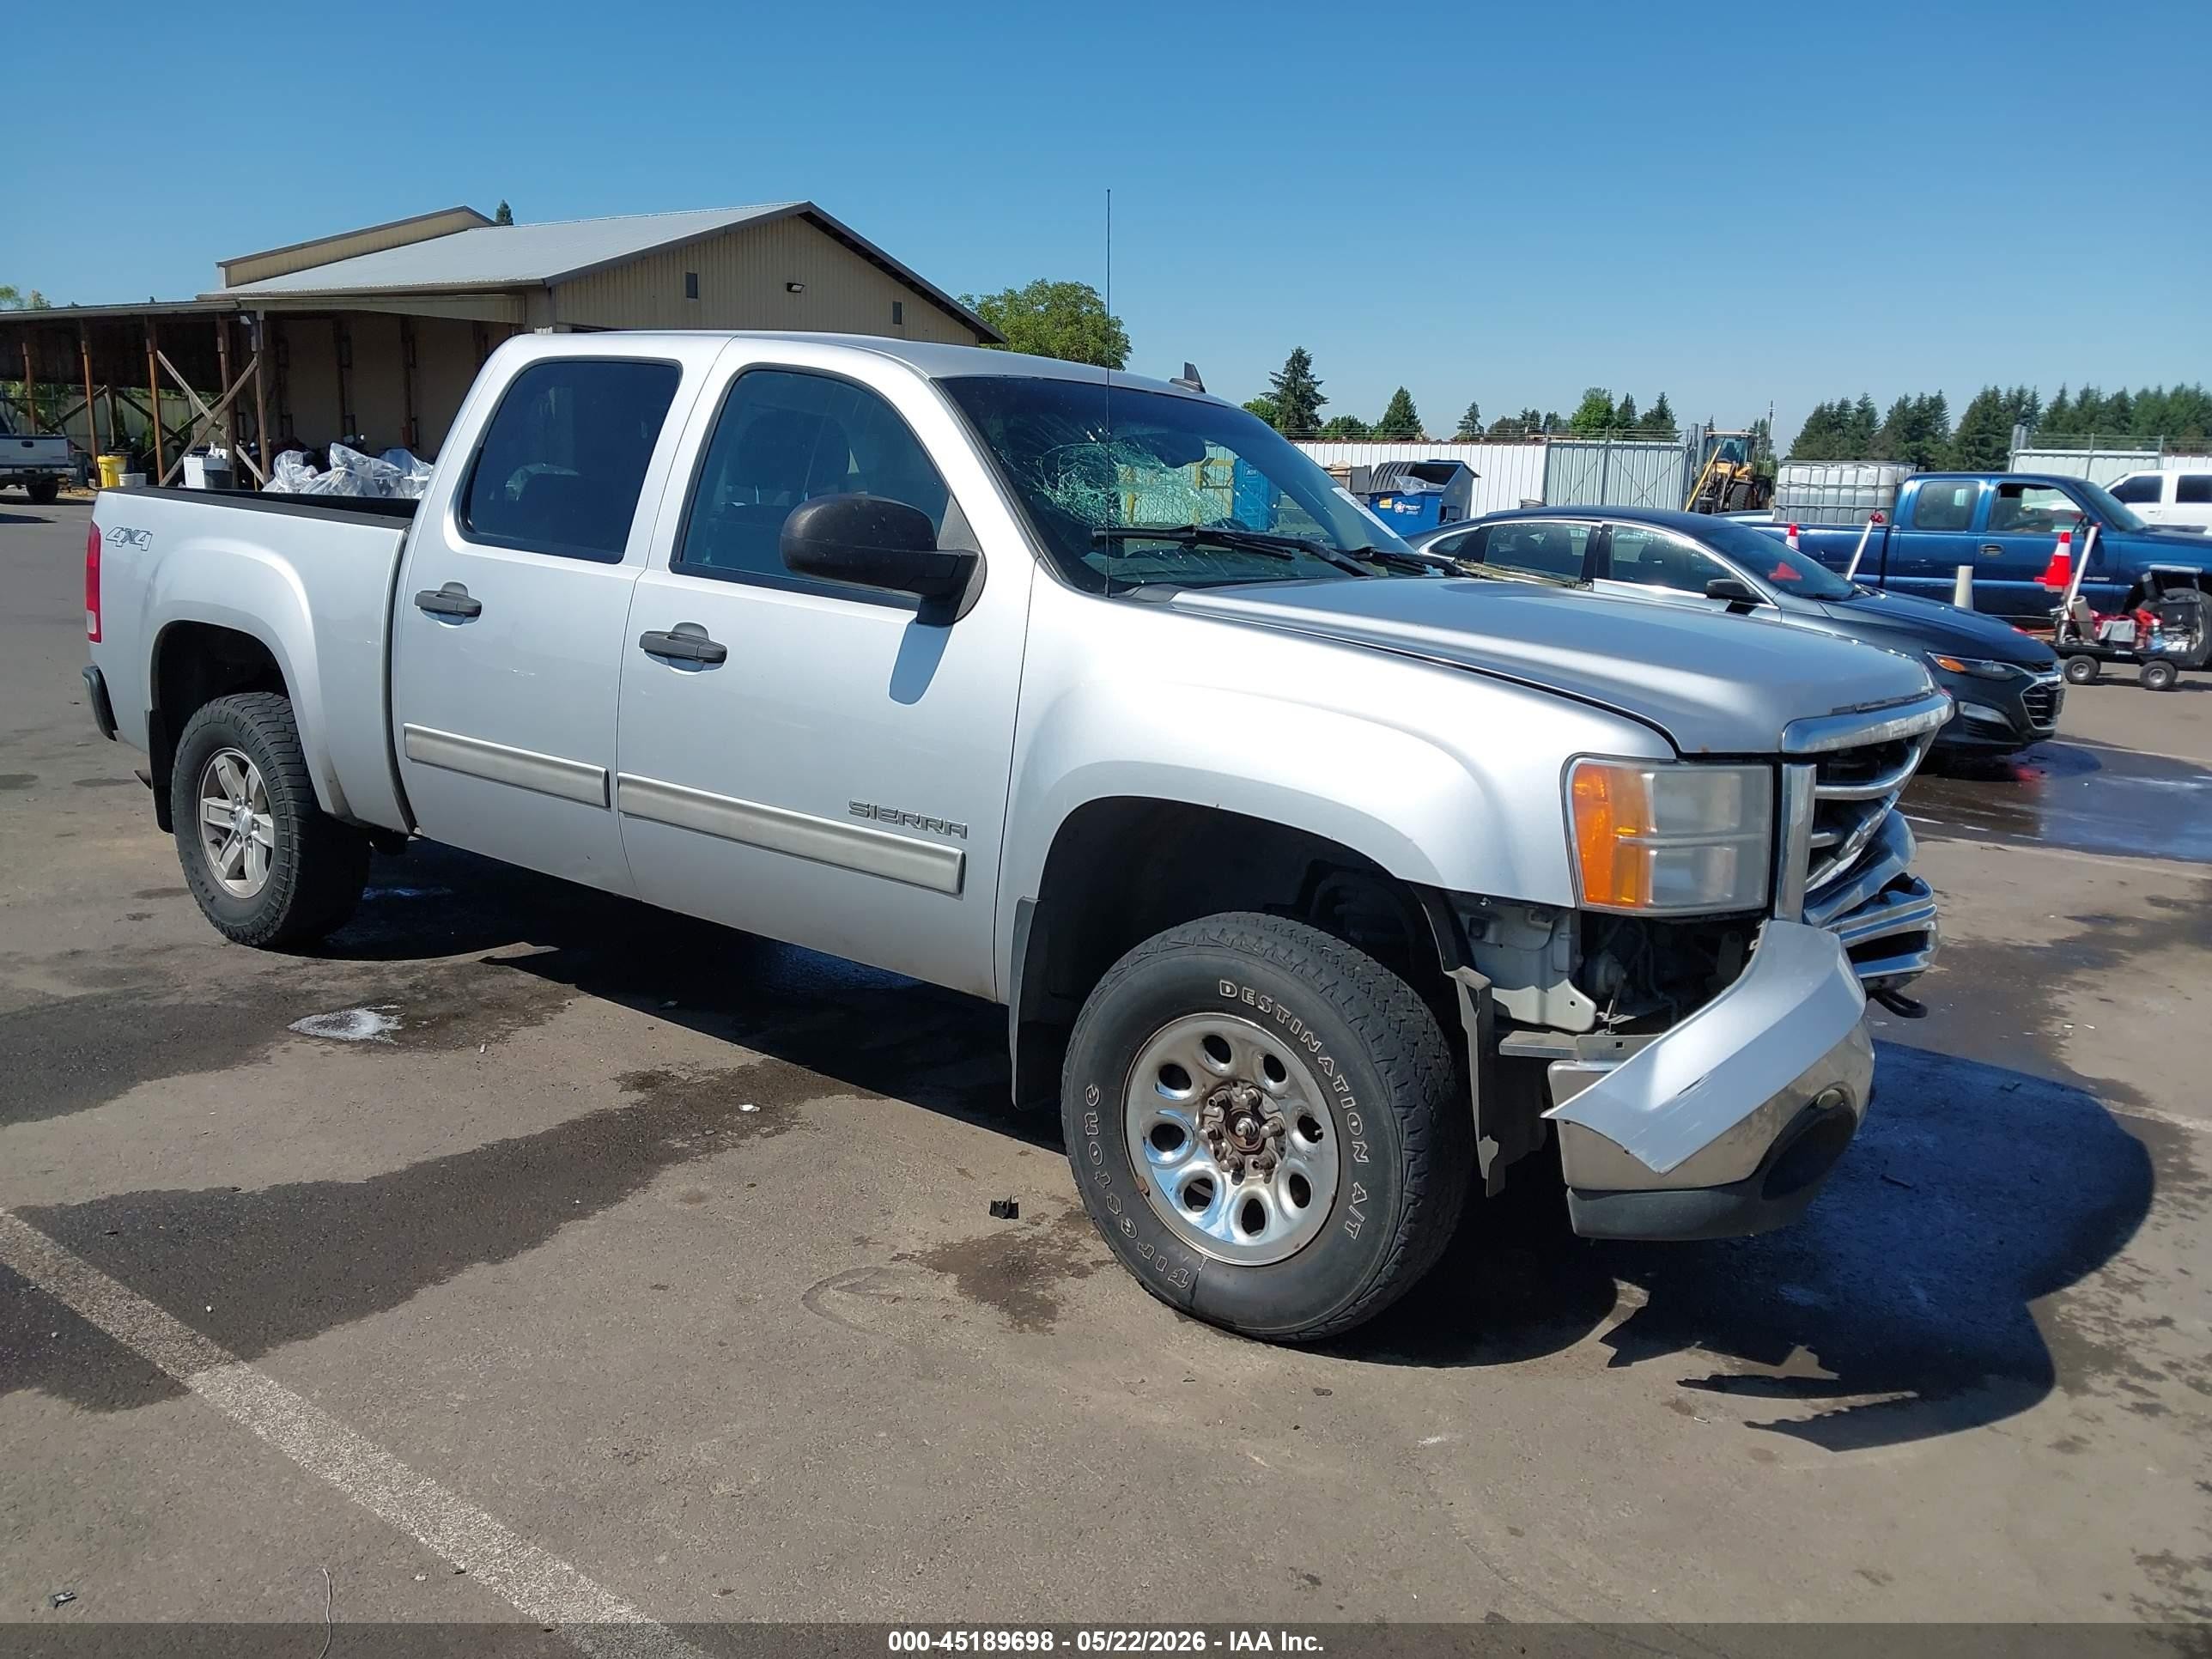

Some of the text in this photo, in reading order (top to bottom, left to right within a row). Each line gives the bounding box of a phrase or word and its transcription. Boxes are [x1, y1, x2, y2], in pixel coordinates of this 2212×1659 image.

[848, 799, 968, 839] SIERRA
[1085, 1084, 1188, 1288] Firestone
[1219, 980, 1370, 1240] DESTINATION A/T
